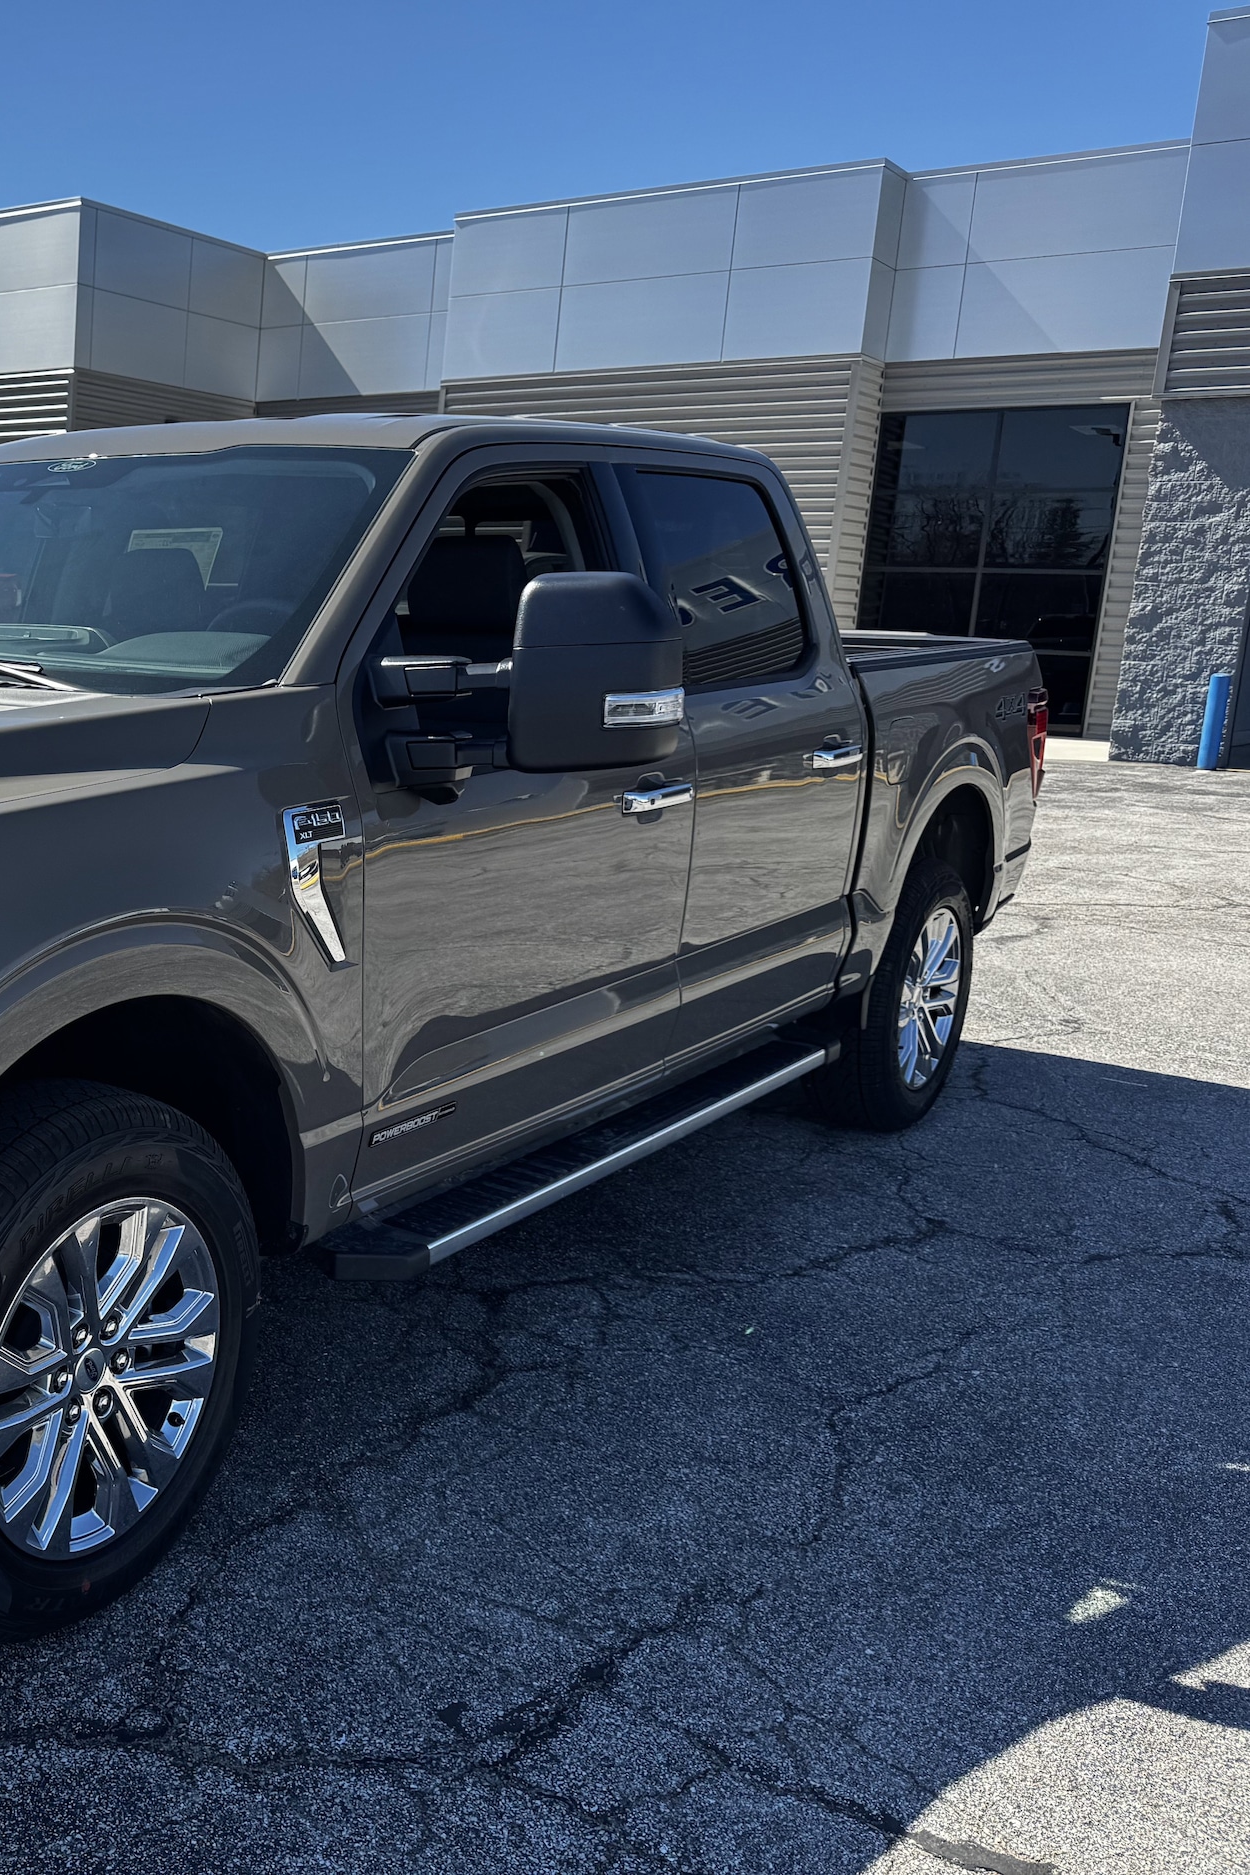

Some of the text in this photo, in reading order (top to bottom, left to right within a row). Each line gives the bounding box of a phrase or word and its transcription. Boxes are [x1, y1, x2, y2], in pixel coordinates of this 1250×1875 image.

[293, 811, 342, 830] F-150
[300, 831, 313, 840] XLT
[372, 1111, 439, 1145] POWERBOOST
[19, 1156, 132, 1254] PIRELLI
